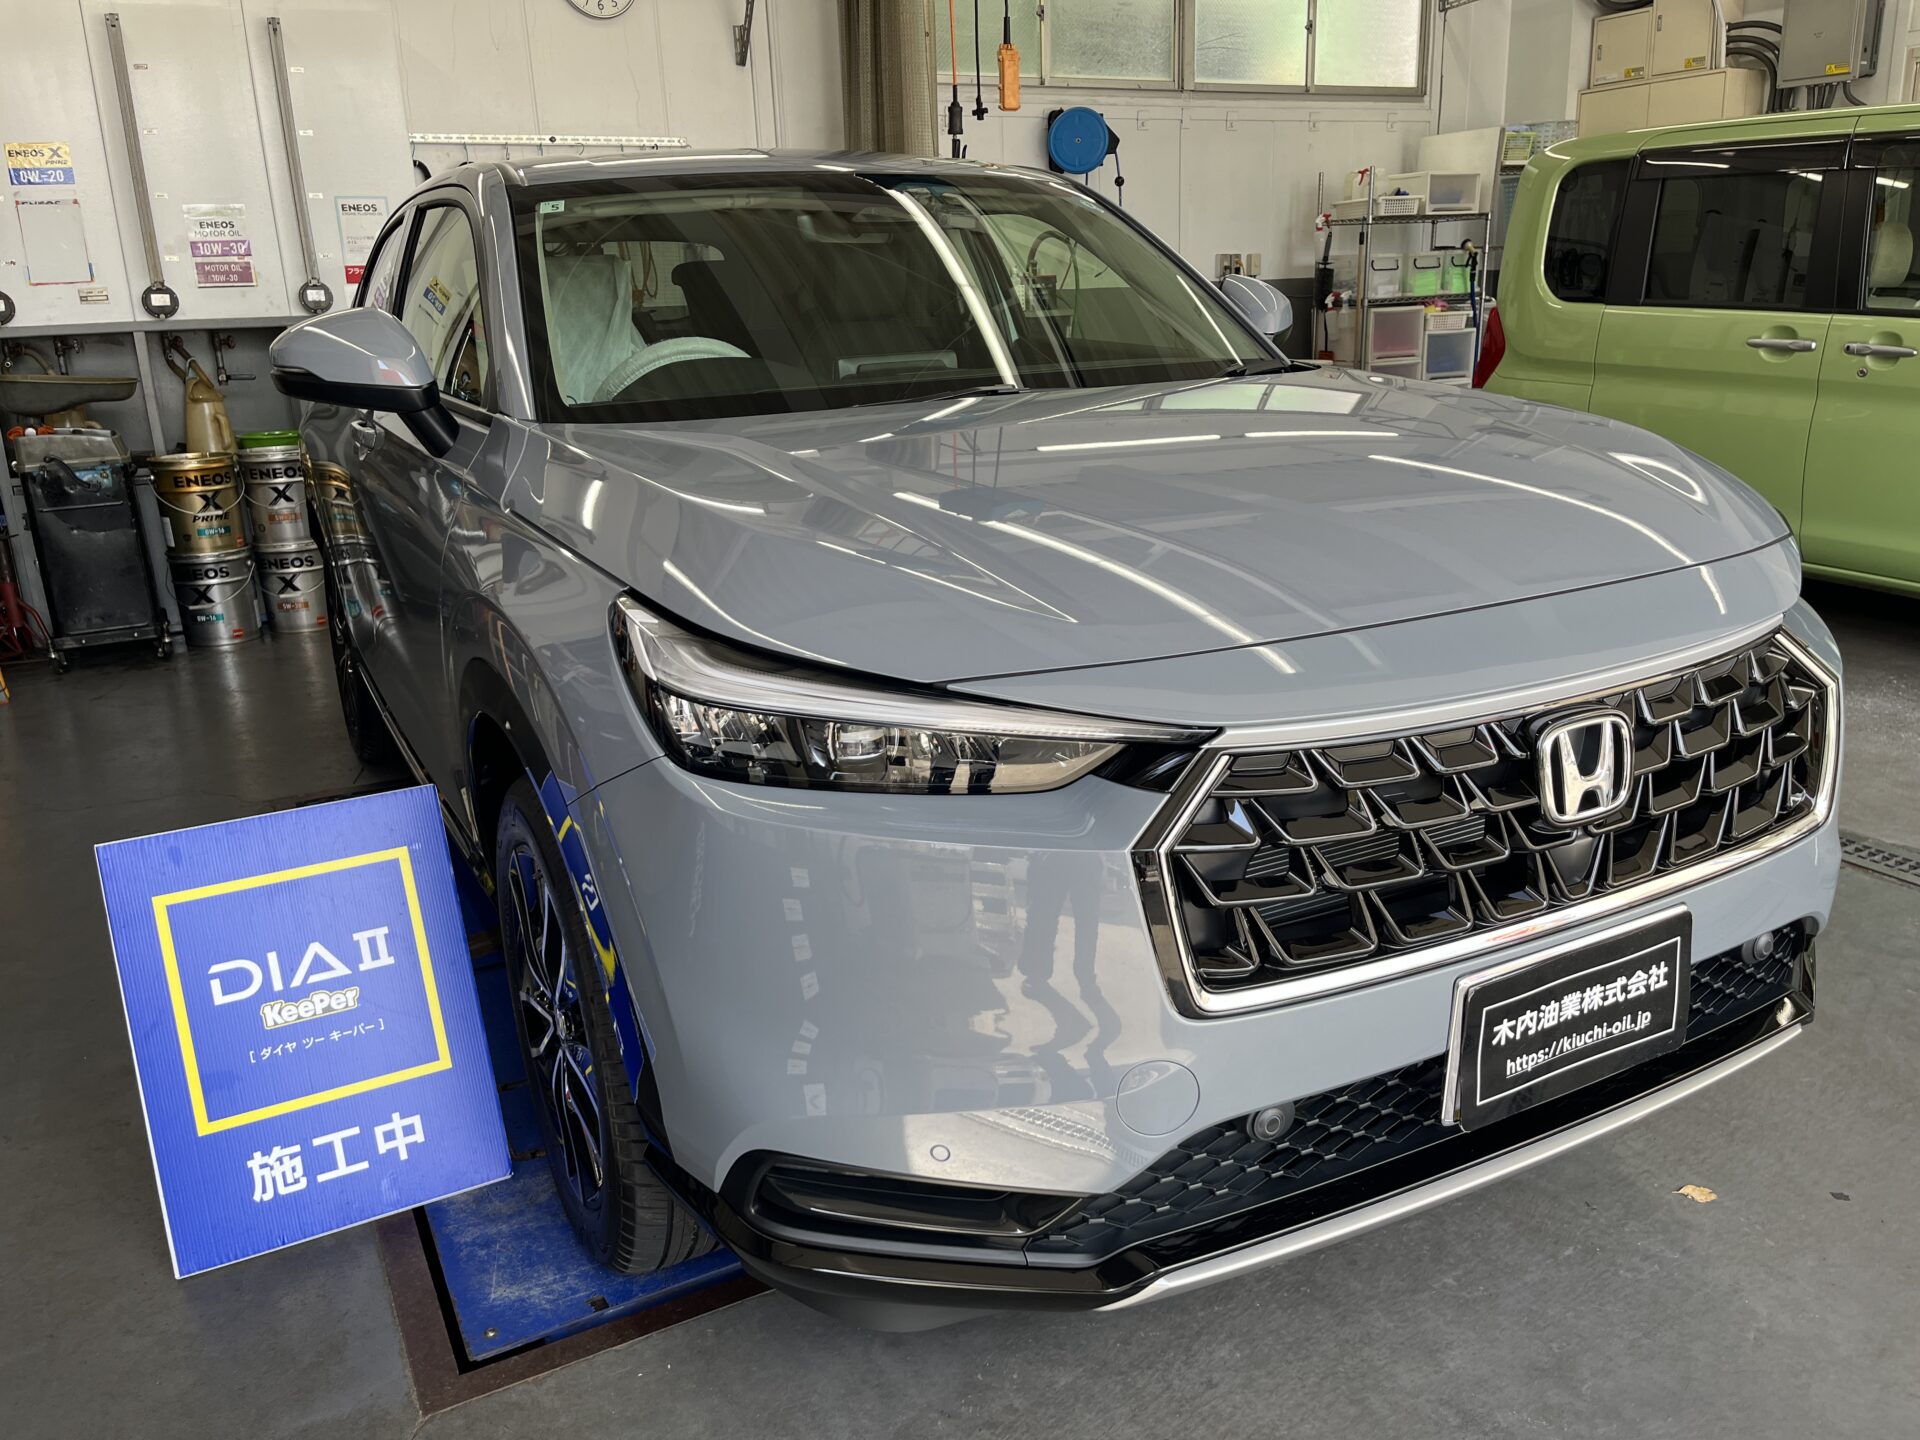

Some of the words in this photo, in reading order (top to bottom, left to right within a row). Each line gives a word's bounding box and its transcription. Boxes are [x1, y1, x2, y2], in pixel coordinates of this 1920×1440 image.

[8, 149, 45, 157] ENEOS
[47, 146, 63, 160] X
[20, 170, 64, 183] 0W-20
[341, 204, 377, 212] ENEOS
[199, 221, 235, 229] ENEOS
[197, 242, 245, 255] 10W-30
[204, 264, 230, 272] MOTOR
[231, 264, 243, 272] OIL
[173, 472, 232, 488] ENEOS
[196, 490, 223, 514] X
[268, 482, 295, 506] X
[207, 941, 353, 1007] DIA
[260, 986, 360, 1030] KeePer
[1491, 960, 1669, 1047] 木内油業株式会社
[1506, 1009, 1652, 1078] https://kiuchi-oil.jp
[246, 1111, 426, 1203] 施工中
